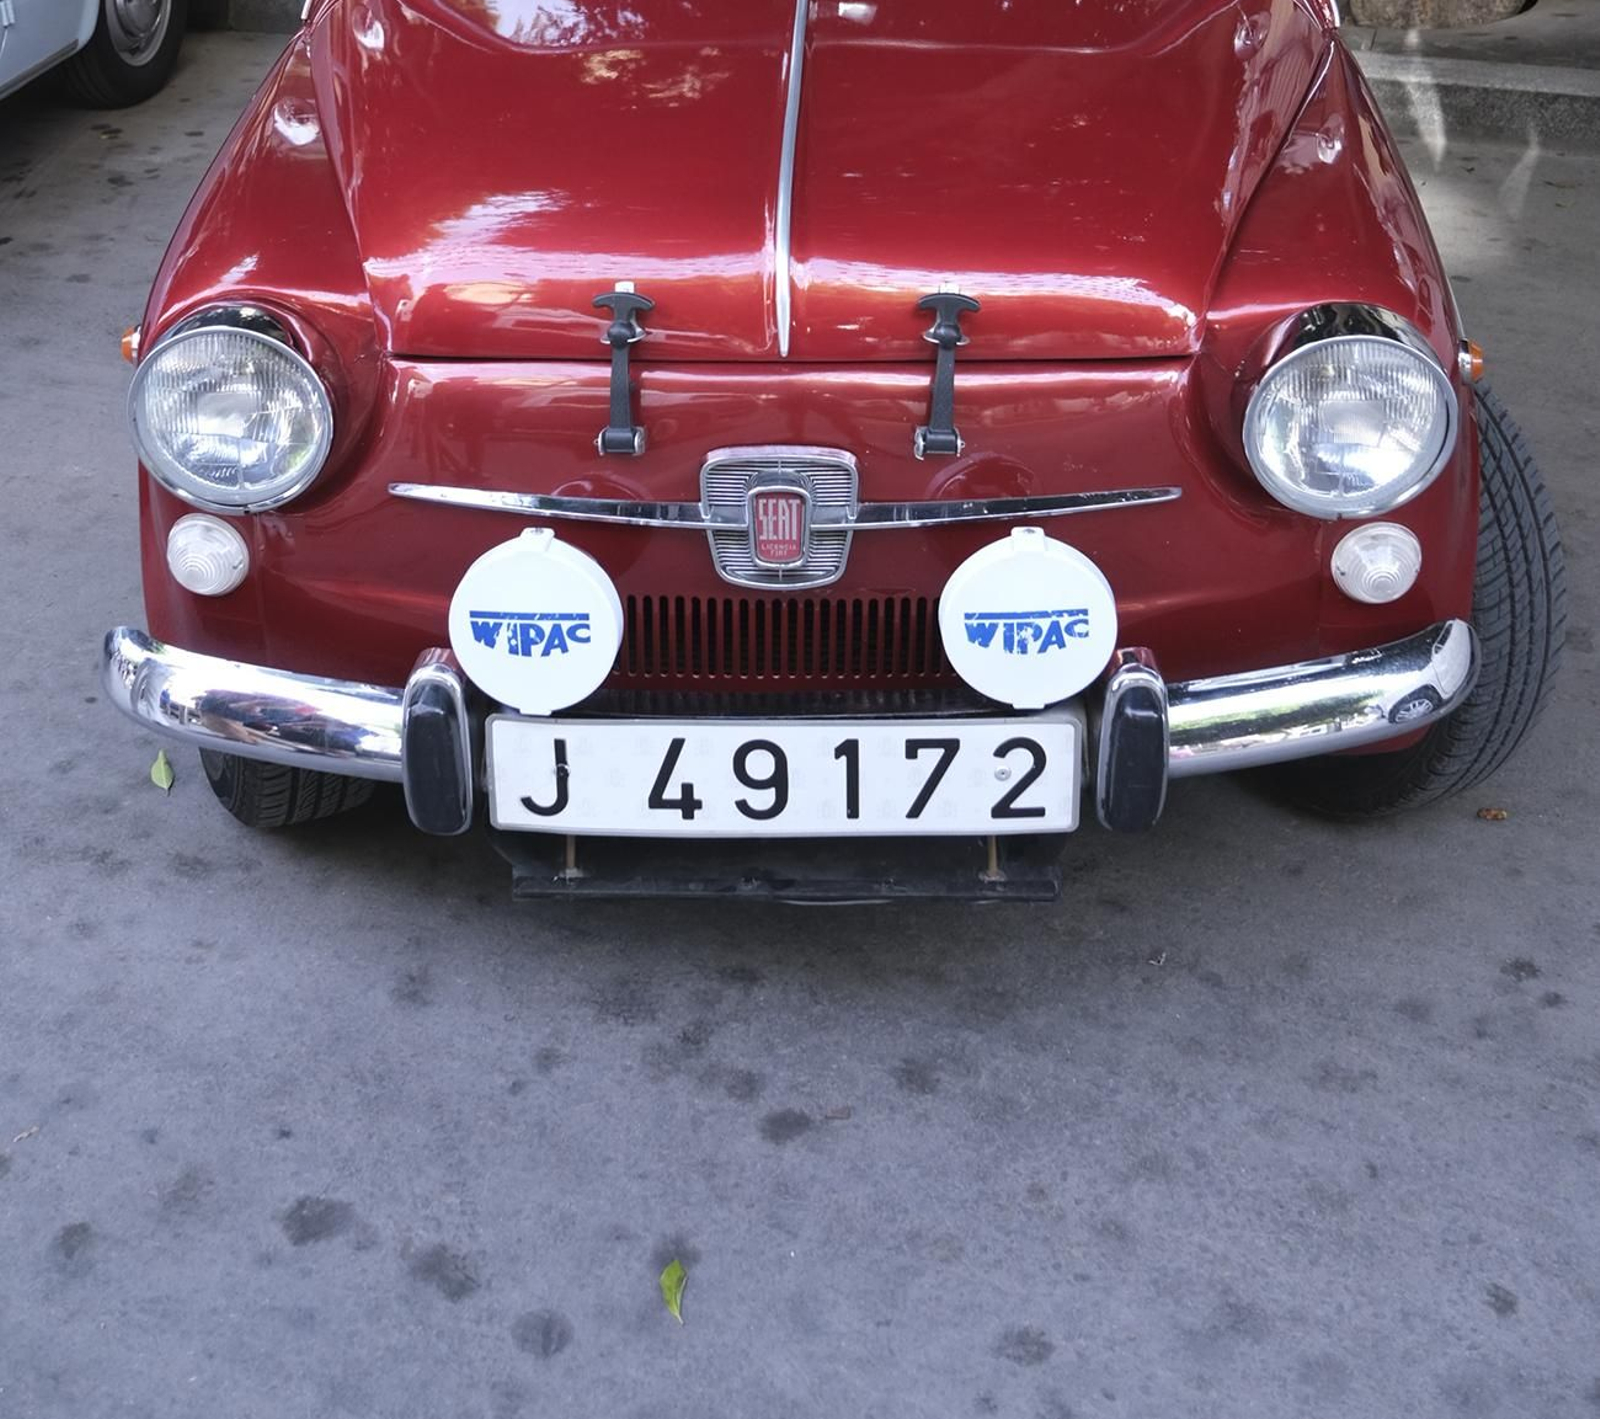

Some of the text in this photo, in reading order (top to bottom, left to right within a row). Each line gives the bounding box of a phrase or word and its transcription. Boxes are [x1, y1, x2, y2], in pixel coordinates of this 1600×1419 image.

[758, 498, 801, 540] SEAT
[470, 620, 591, 657] WIPAC
[964, 618, 1090, 655] WIPAC
[519, 736, 1047, 820] J 49172
